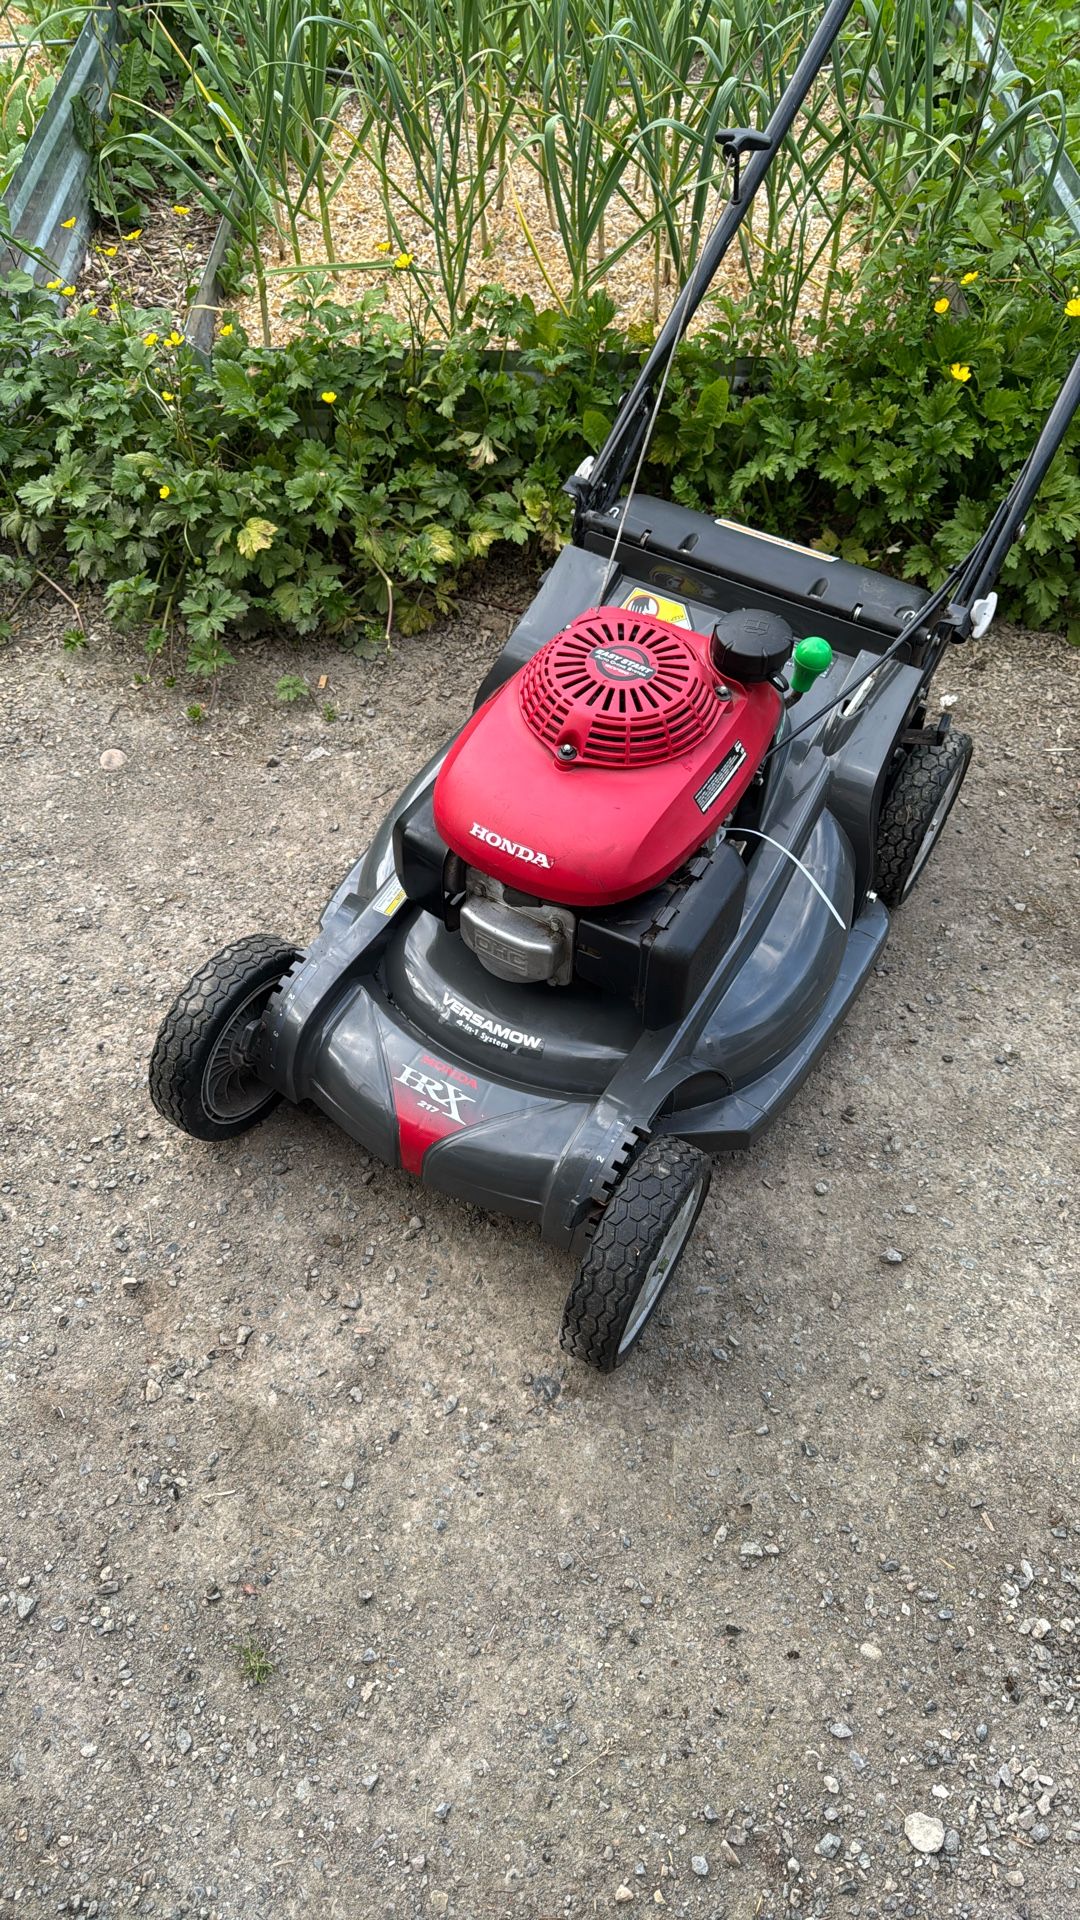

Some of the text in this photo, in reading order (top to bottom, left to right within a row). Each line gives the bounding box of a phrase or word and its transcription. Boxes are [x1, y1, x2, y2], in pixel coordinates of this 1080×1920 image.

[594, 649, 623, 661] EASY
[620, 658, 654, 674] START
[469, 821, 551, 869] HONDA
[442, 992, 542, 1049] VERSAMOW
[480, 1032, 509, 1049] System
[421, 1055, 478, 1089] HONDA
[393, 1063, 477, 1126] HRX
[416, 1100, 440, 1113] 217
